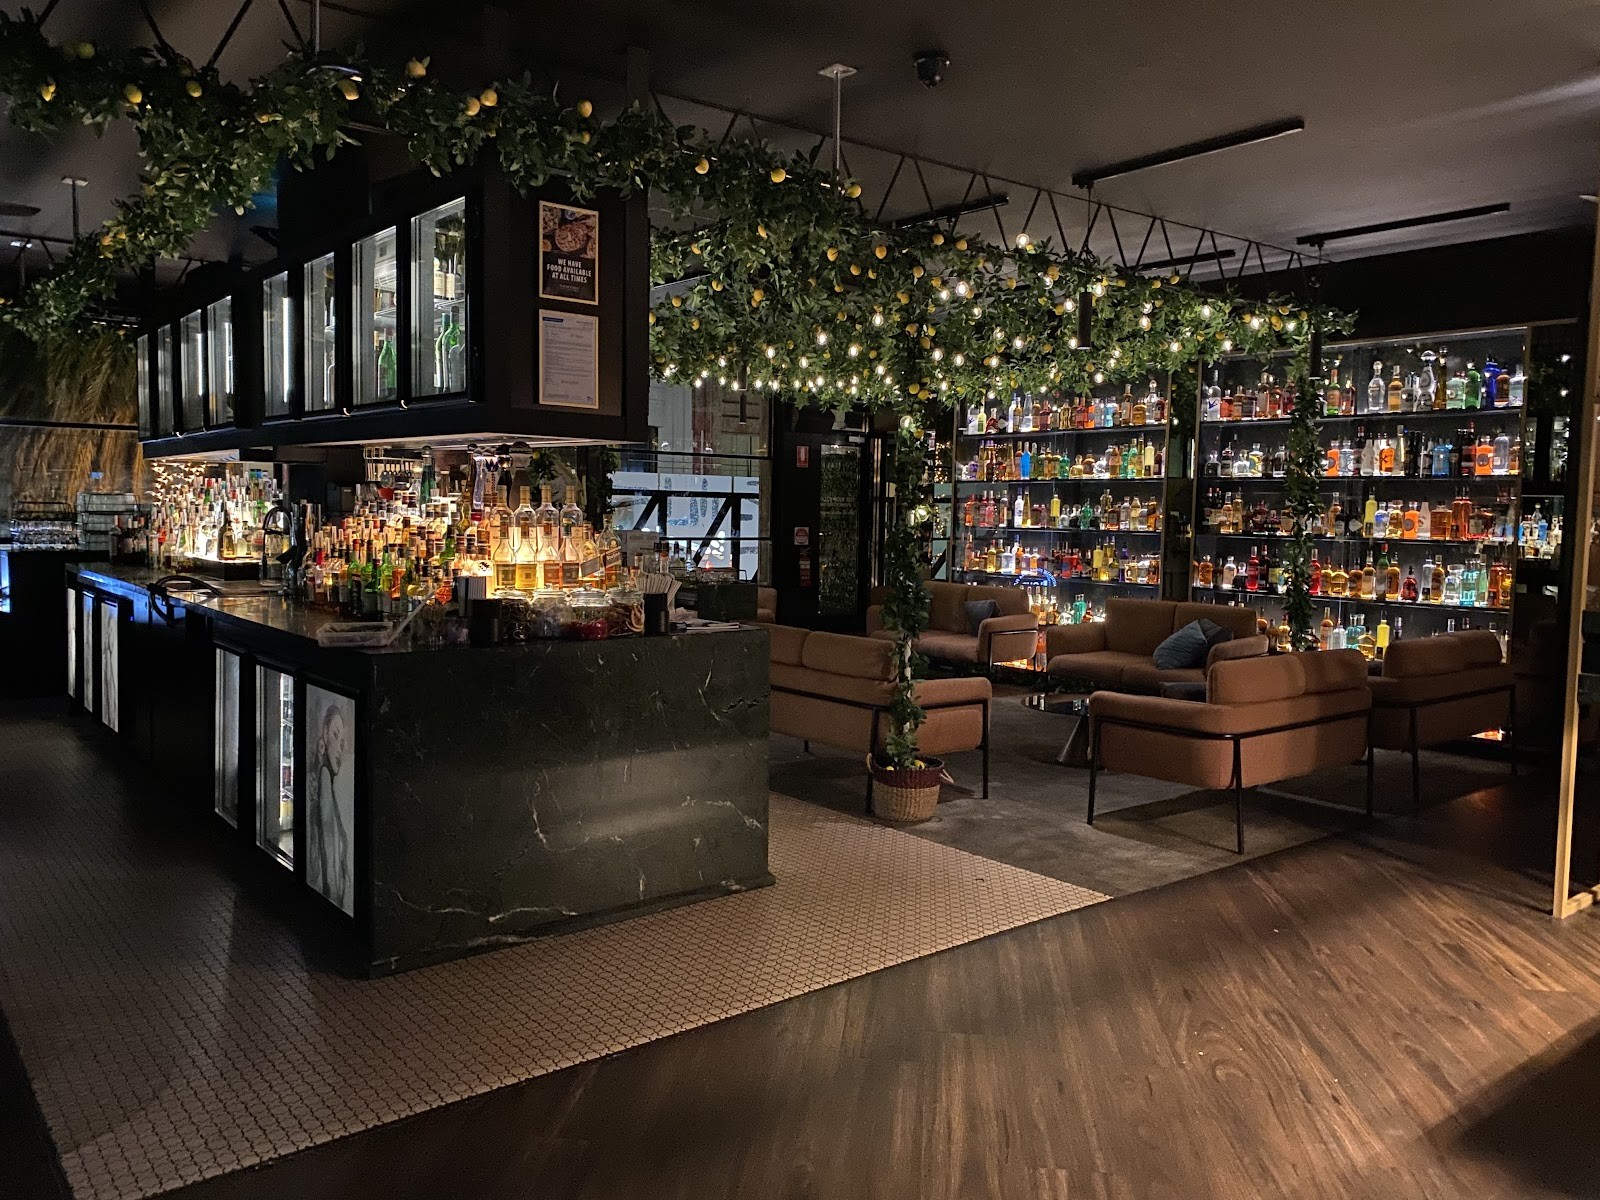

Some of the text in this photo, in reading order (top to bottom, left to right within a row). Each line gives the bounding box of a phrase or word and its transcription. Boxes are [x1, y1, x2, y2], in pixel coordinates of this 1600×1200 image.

[558, 258, 582, 268] WE HAVE
[546, 263, 592, 277] FOOD AVAILABLE
[560, 273, 570, 281] ALL
[571, 275, 587, 283] TIMES
